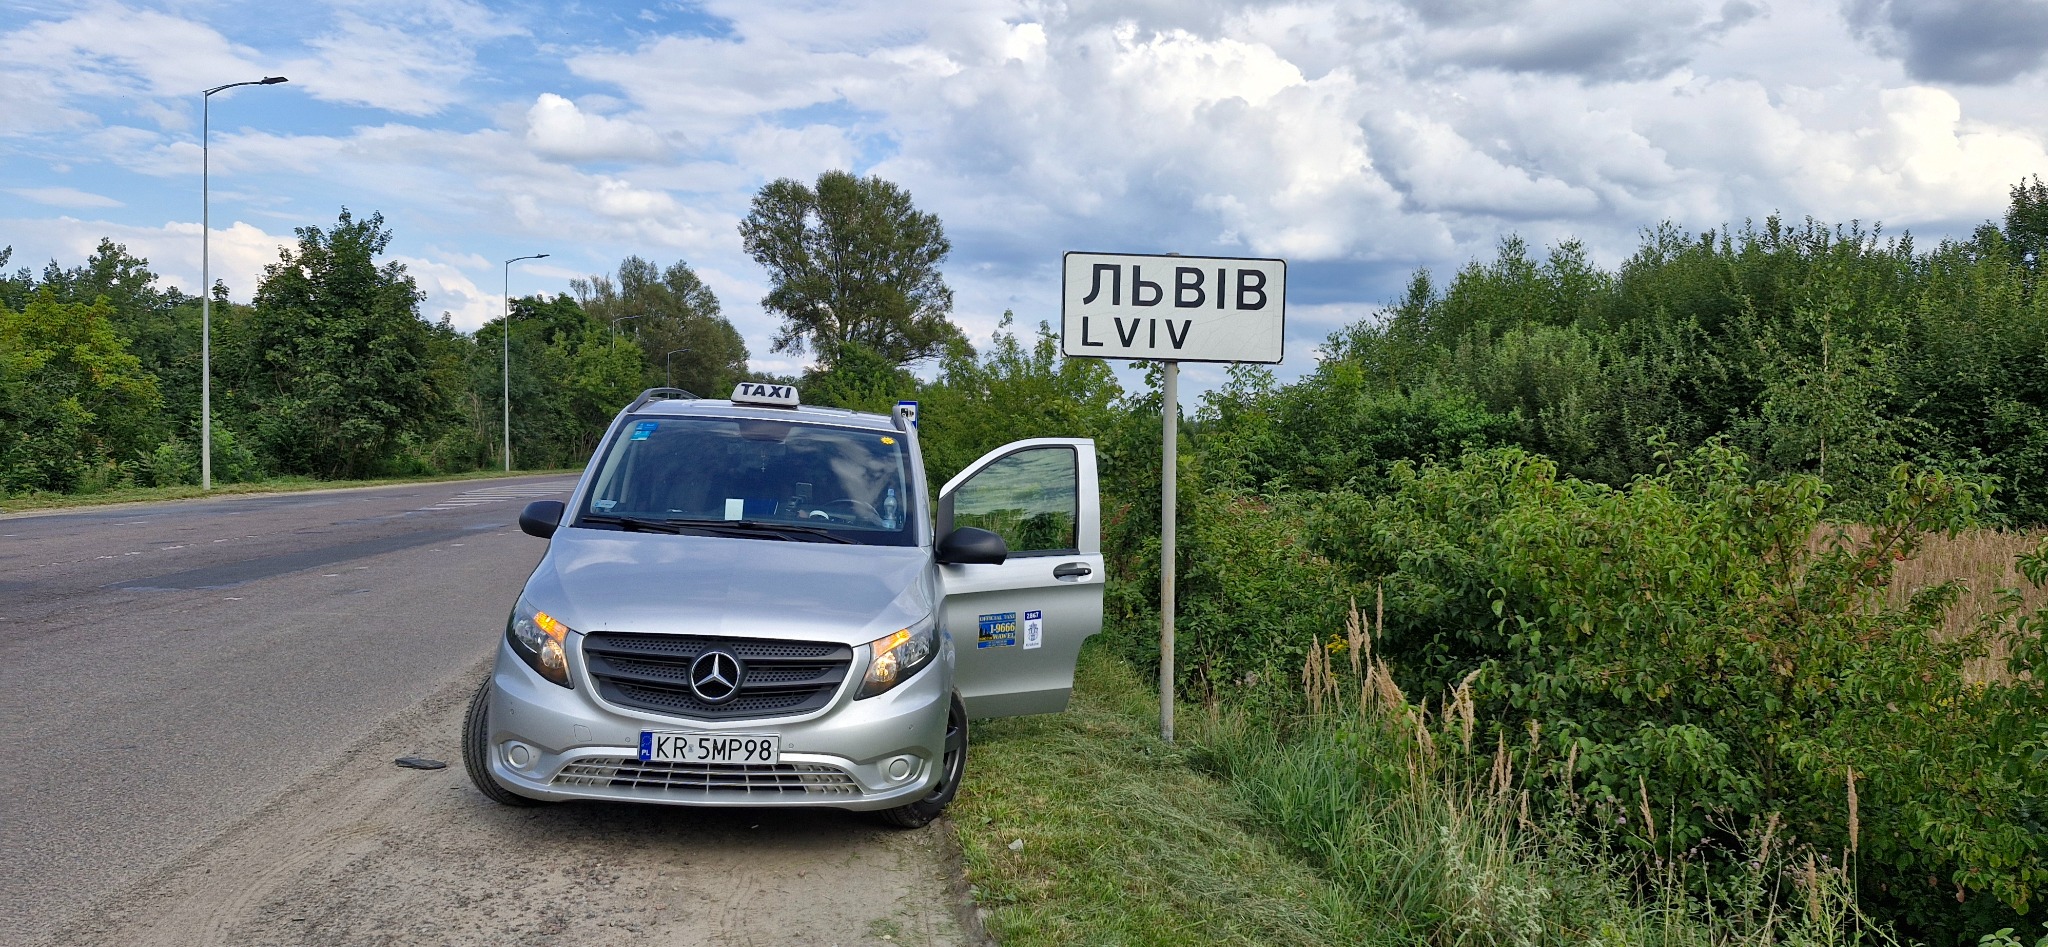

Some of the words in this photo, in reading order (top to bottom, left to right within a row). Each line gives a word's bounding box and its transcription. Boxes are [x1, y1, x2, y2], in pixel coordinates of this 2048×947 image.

[1082, 263, 1267, 310] ЛЬВІВ
[1081, 316, 1192, 350] LVIV
[740, 383, 792, 399] TAXI
[656, 736, 687, 759] KR
[697, 738, 772, 761] 5MP98
